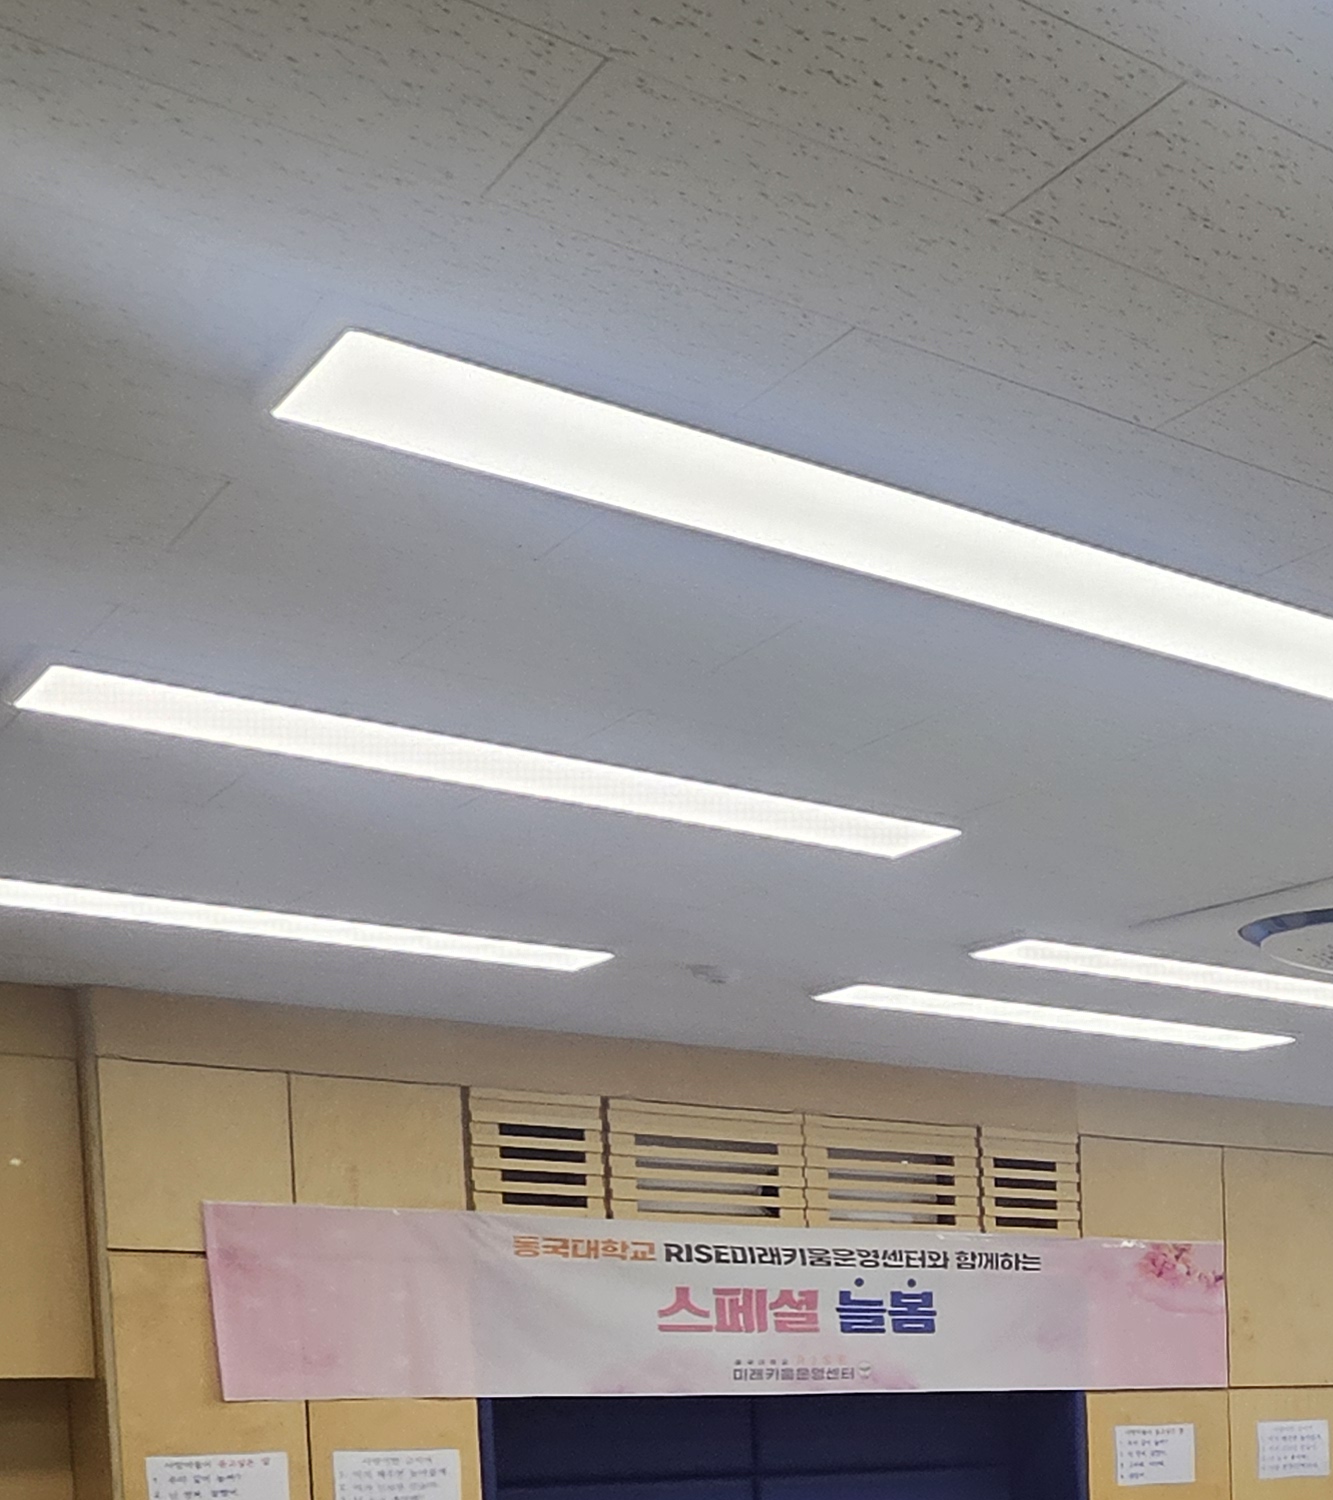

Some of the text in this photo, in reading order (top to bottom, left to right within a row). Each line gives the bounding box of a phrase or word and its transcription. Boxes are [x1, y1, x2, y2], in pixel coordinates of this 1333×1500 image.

[512, 1235, 1042, 1272] 동국대학교 RISE미래키움운영센터와 함께하는
[657, 1278, 939, 1334] 스페셜 늘봄
